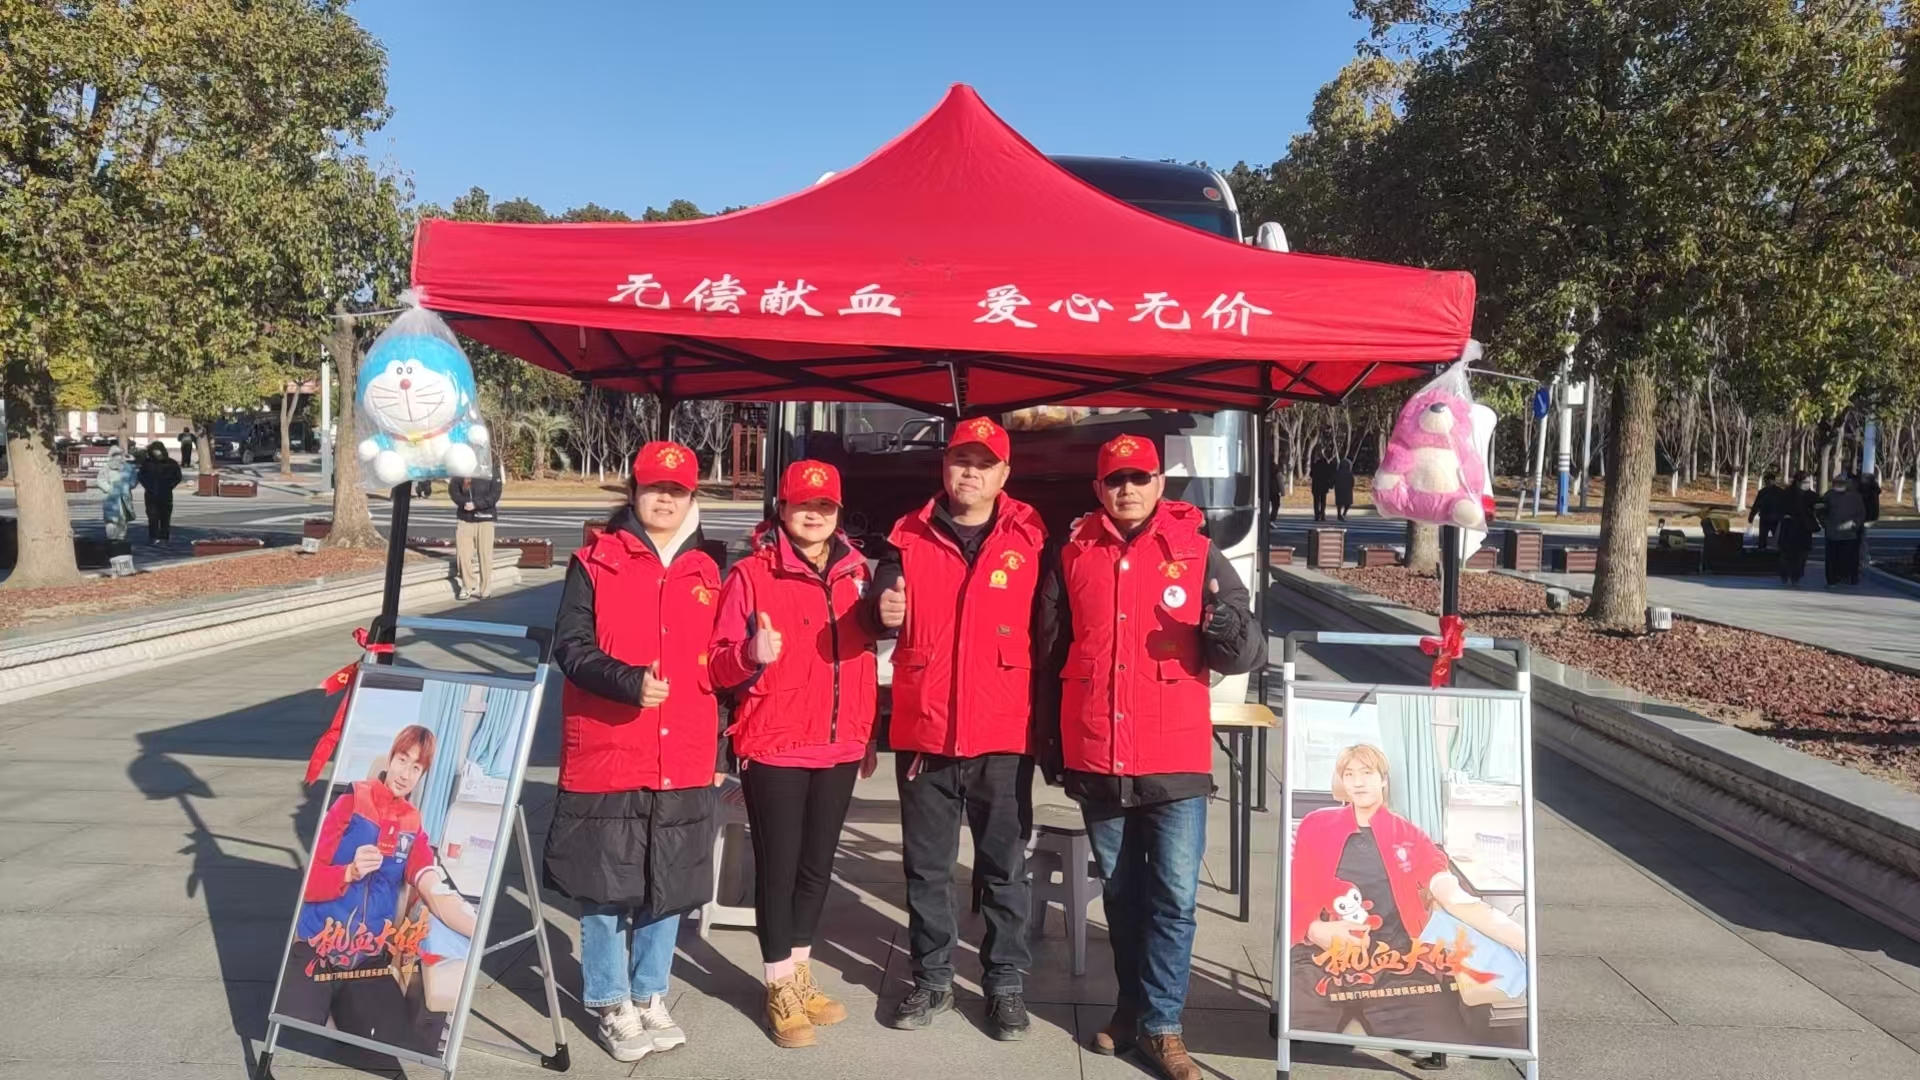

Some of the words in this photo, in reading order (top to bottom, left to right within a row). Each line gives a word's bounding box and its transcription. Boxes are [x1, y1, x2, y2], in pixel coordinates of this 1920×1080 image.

[608, 273, 902, 317] 无偿献血
[974, 284, 1273, 336] 爱心无价
